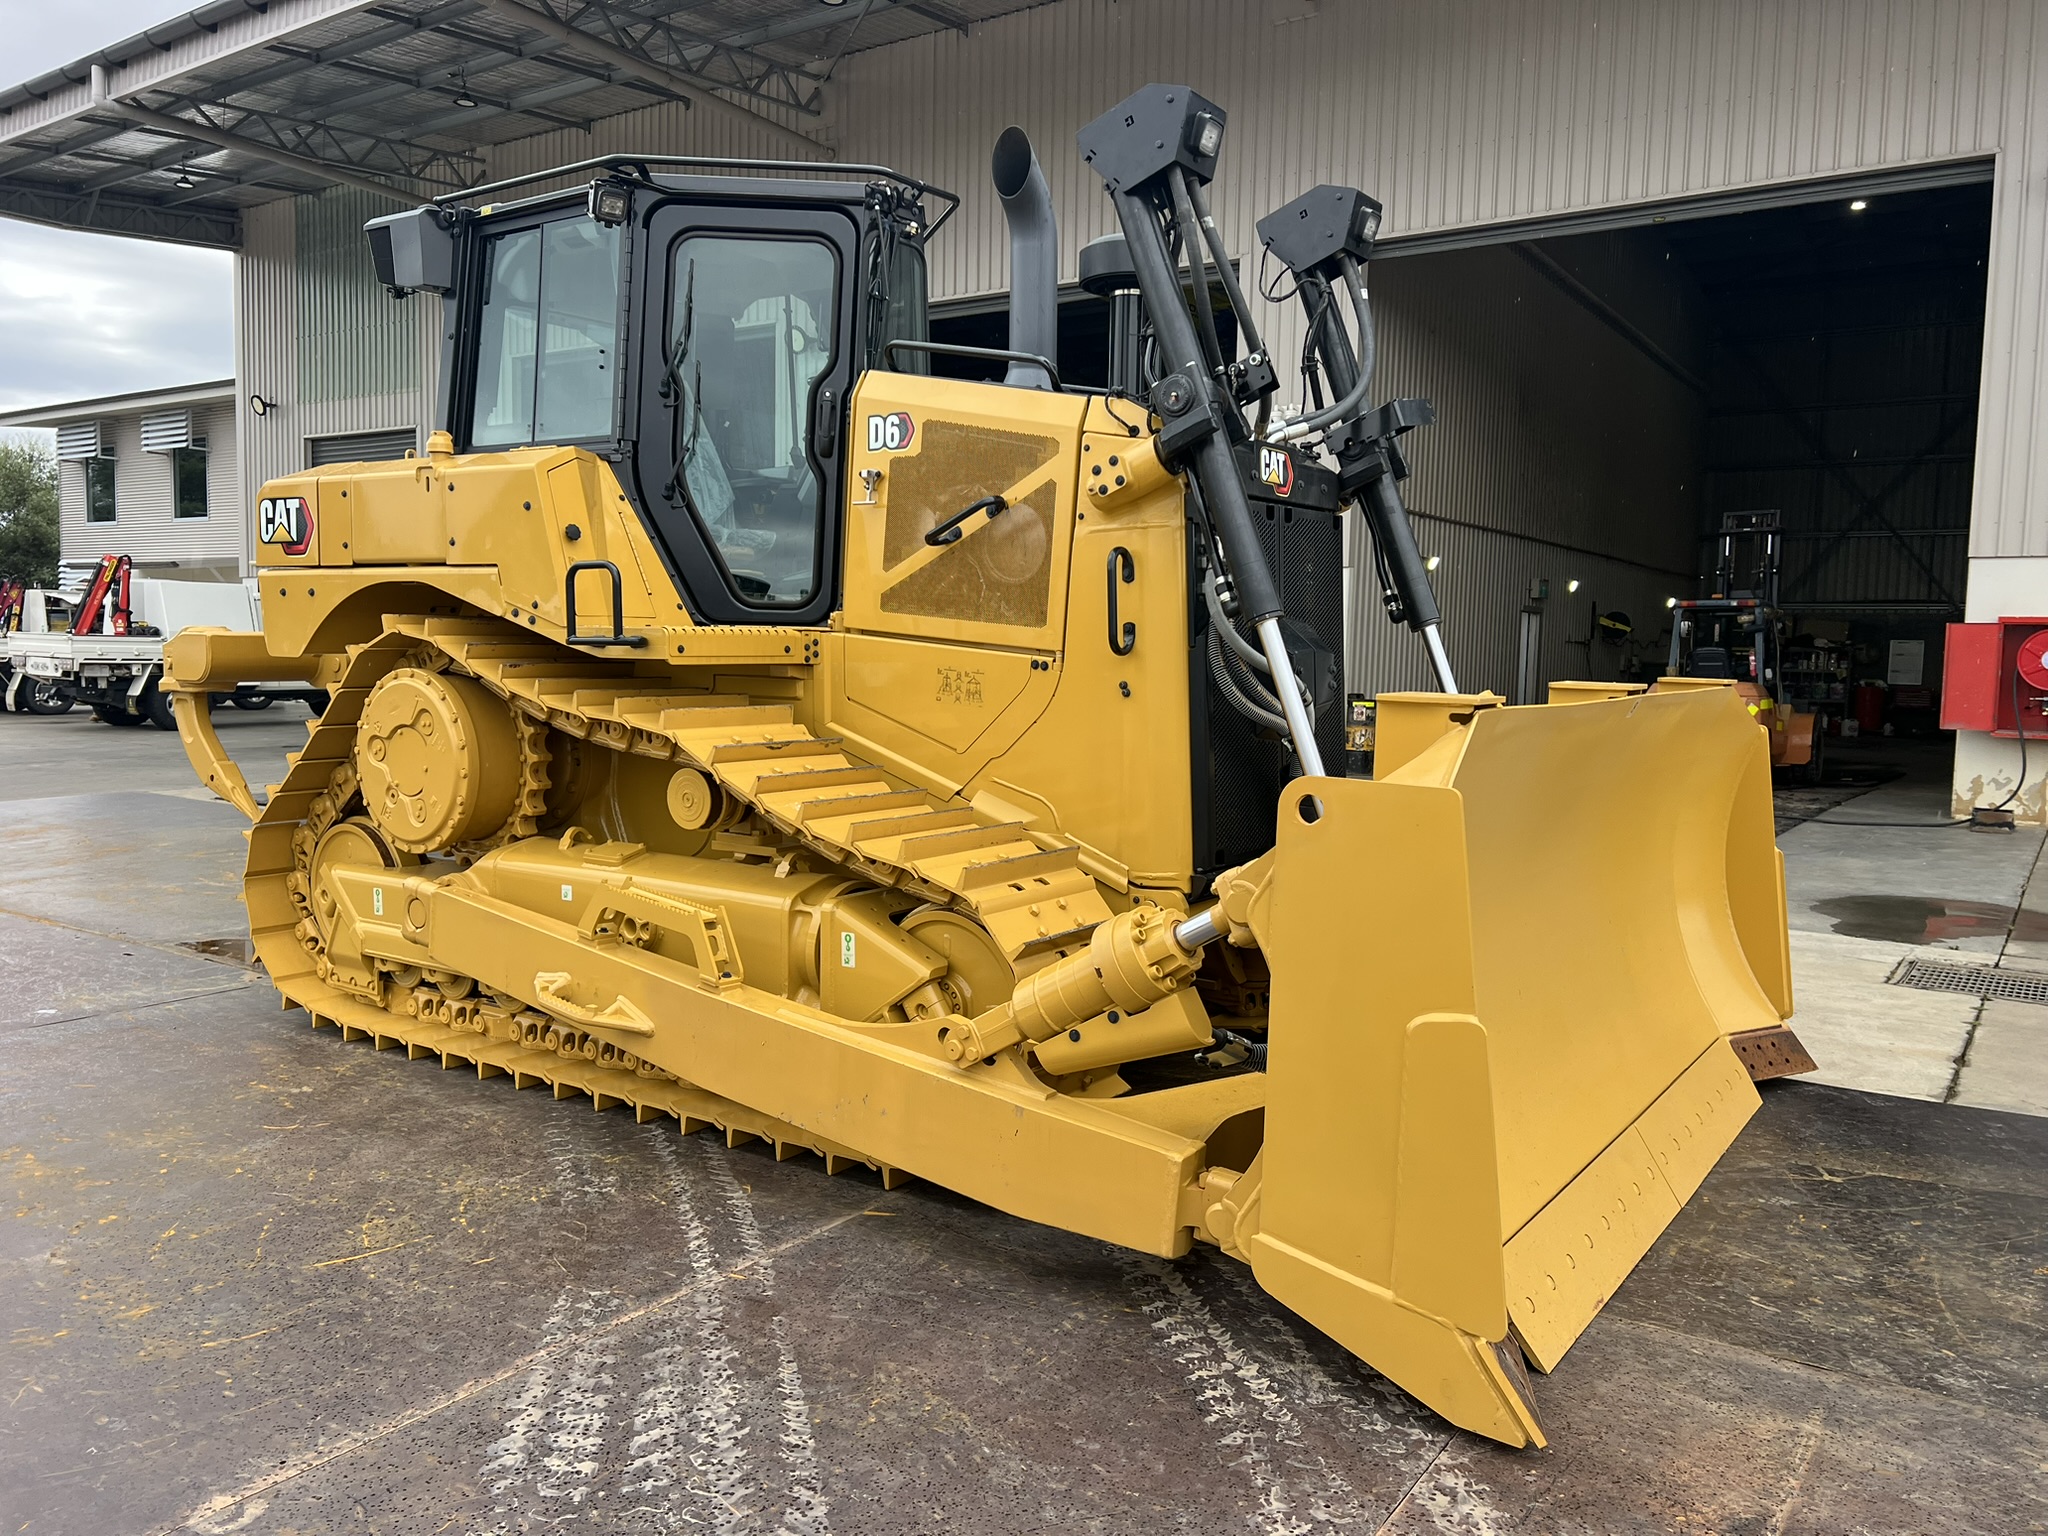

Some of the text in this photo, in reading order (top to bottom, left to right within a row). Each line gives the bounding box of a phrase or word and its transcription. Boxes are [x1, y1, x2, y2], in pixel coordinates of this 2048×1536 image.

[869, 414, 900, 450] D6
[1261, 448, 1286, 485] CAT
[260, 499, 300, 543] CAT
